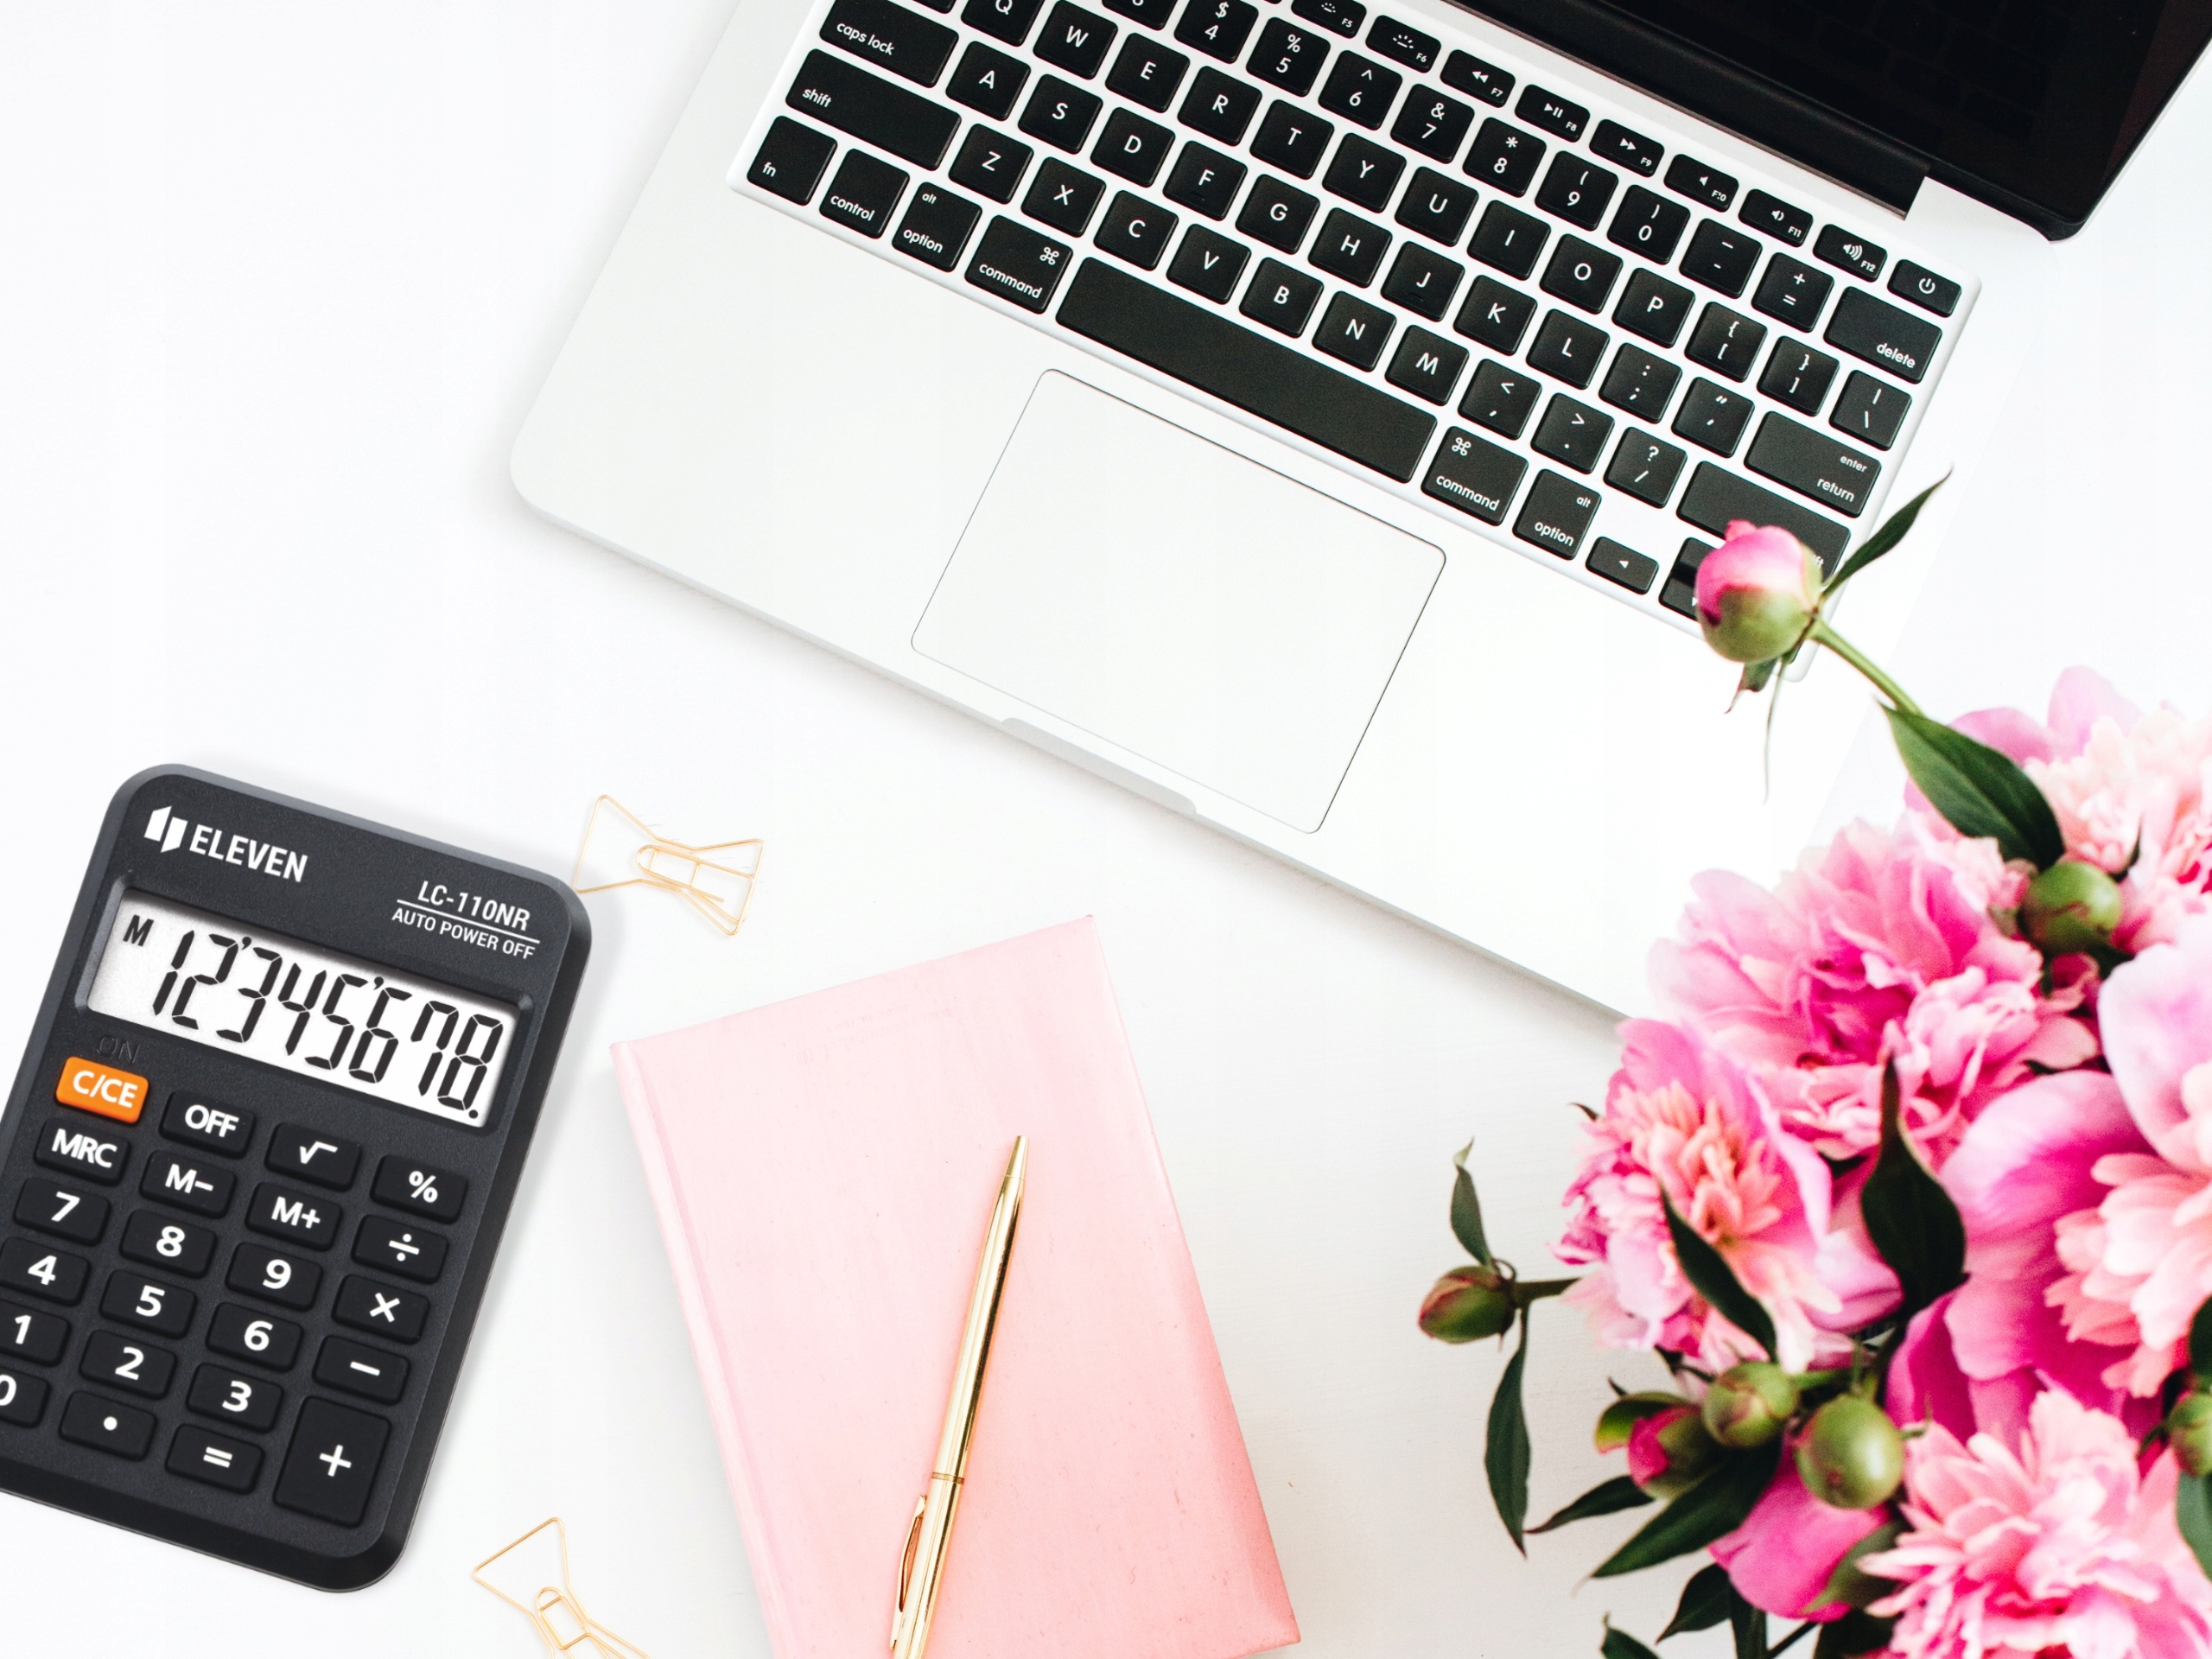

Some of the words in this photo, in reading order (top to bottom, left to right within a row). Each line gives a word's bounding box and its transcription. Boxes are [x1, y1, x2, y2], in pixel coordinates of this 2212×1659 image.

[1205, 24, 1219, 41] 4
[1341, 17, 1353, 28] F5
[836, 21, 867, 46] caps
[868, 34, 894, 55] lock
[1065, 25, 1089, 48] W
[1275, 57, 1292, 73] 5
[1415, 52, 1427, 63] F6
[978, 70, 995, 89] A
[1140, 60, 1157, 80] E
[802, 88, 831, 108] shift
[1349, 91, 1363, 106] 6
[1491, 87, 1503, 97] F7
[1052, 102, 1069, 120] S
[1211, 94, 1229, 114] R
[1287, 127, 1302, 145] T
[1421, 123, 1437, 139] 7
[1566, 121, 1577, 131] F8
[1123, 134, 1142, 154] D
[762, 162, 777, 177] fn
[982, 150, 1001, 172] Z
[1359, 160, 1375, 179] Y
[1493, 157, 1508, 174] 8
[1640, 156, 1652, 167] F9
[1198, 168, 1215, 186] F
[922, 194, 937, 205] alt
[1053, 184, 1074, 206] X
[1429, 194, 1448, 213] U
[1567, 191, 1580, 207] 9
[830, 193, 876, 222] control
[1269, 203, 1288, 221] G
[1128, 219, 1146, 238] C
[1504, 229, 1516, 246] I
[1638, 225, 1652, 241] 0
[1788, 226, 1802, 238] F11
[903, 227, 944, 254] option
[1340, 234, 1361, 256] H
[1204, 251, 1220, 270] V
[1859, 259, 1877, 273] F12
[978, 261, 1043, 300] command
[1416, 271, 1432, 288] J
[1573, 263, 1592, 281] O
[1274, 285, 1290, 304] B
[1647, 296, 1664, 313] P
[1487, 302, 1507, 324] K
[1345, 318, 1366, 340] N
[1561, 337, 1572, 358] L
[1876, 342, 1916, 369] delete
[1415, 352, 1439, 375] M
[1840, 454, 1868, 473] enter
[1435, 475, 1500, 512] command
[1816, 477, 1855, 502] return
[1576, 497, 1592, 508] alt
[1534, 522, 1575, 548] option
[189, 823, 308, 883] ELEVEN
[417, 880, 531, 932] LC-110NR
[123, 915, 154, 948] M
[391, 907, 436, 931] AUTO
[439, 920, 499, 950] POWER
[502, 939, 536, 960] OFF
[73, 1070, 138, 1109] C/CE
[184, 1104, 239, 1138] OFF
[51, 1128, 118, 1168] MRC
[51, 1191, 80, 1222] 7
[271, 1196, 321, 1229] M+
[156, 1225, 186, 1257] 8
[28, 1255, 57, 1286] 4
[262, 1259, 292, 1289] 9
[136, 1285, 165, 1317] 5
[15, 1314, 32, 1344] 1
[244, 1320, 273, 1351] 6
[115, 1346, 144, 1381] 2
[221, 1380, 252, 1412] 3
